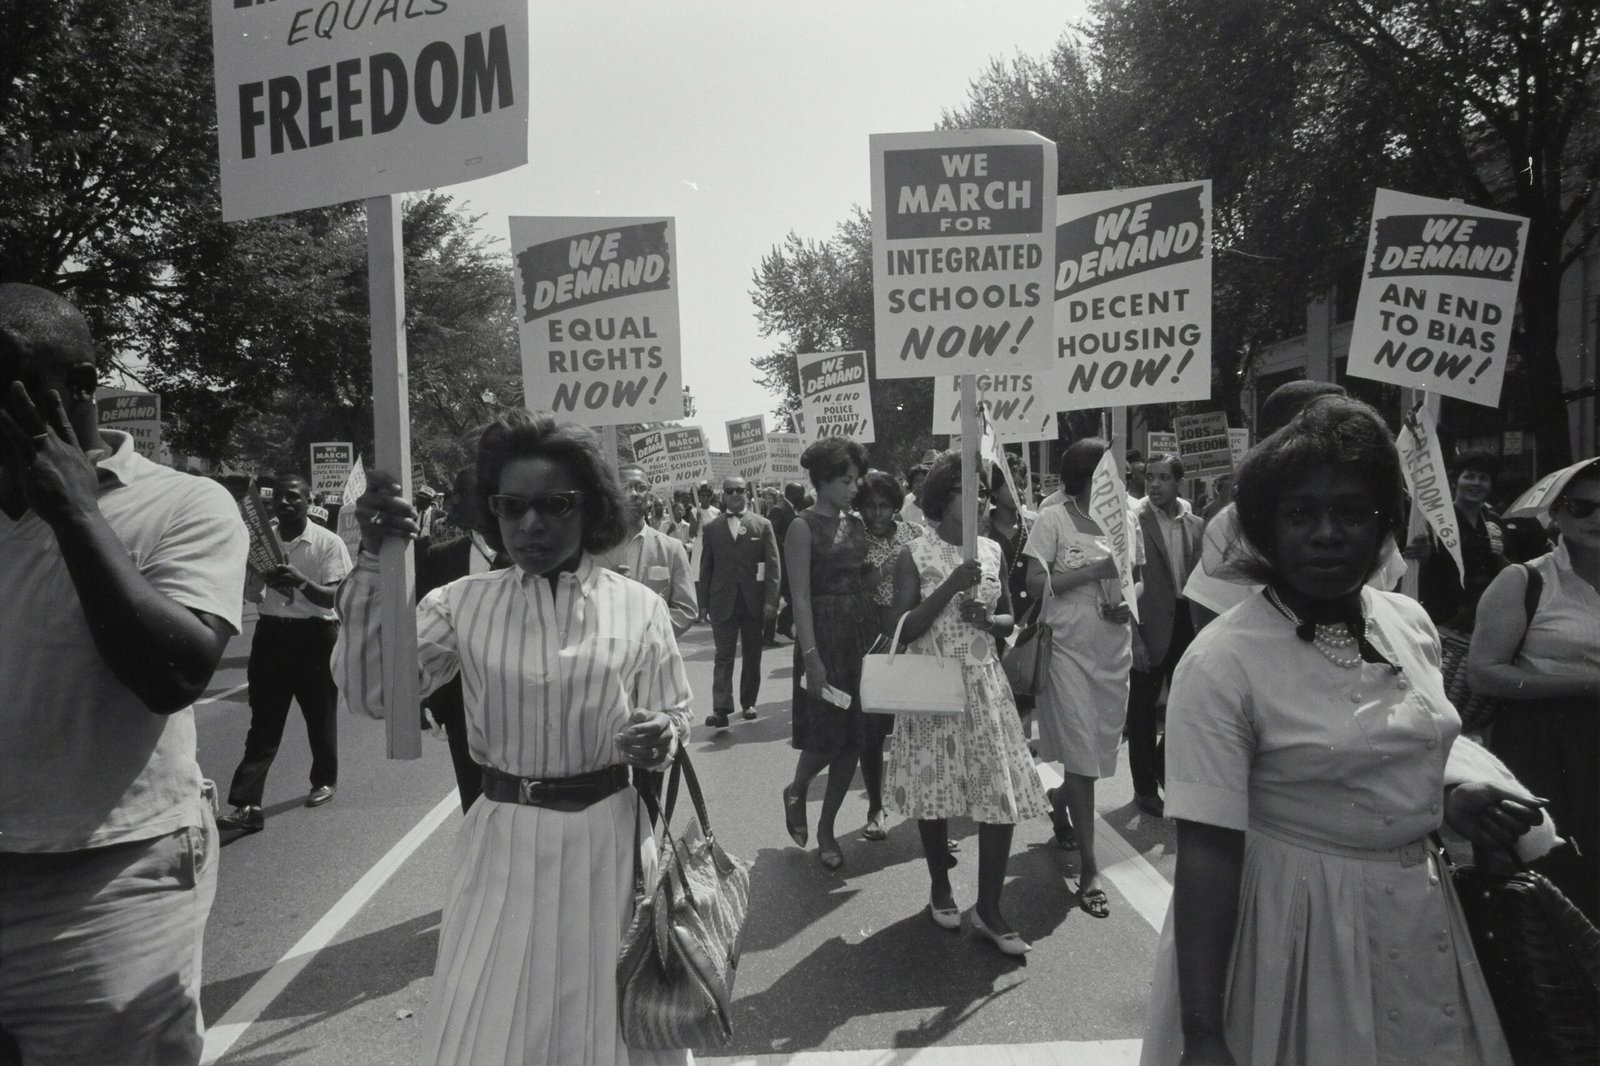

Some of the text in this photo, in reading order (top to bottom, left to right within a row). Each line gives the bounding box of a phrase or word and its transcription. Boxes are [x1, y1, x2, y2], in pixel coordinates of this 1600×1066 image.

[239, 24, 514, 160] FREEDOM
[941, 153, 988, 177] WE
[897, 180, 1031, 214] MARCH
[940, 216, 991, 232] FOR
[1095, 202, 1152, 245] WE
[1422, 217, 1477, 243] WE
[569, 232, 621, 269] WE
[887, 243, 1043, 276] INTEGRATED
[1055, 221, 1198, 291] DEMAND
[1379, 244, 1513, 272] DEMAND
[533, 254, 664, 310] DEMAND
[888, 282, 1041, 314] SCHOOLS
[1070, 288, 1190, 323] DECENT
[1379, 283, 1502, 325] AN END
[548, 316, 657, 342] EQUAL
[900, 315, 1034, 361] NOW!
[1379, 310, 1495, 353] TO BIAS
[1058, 323, 1201, 358] HOUSING
[549, 346, 663, 373] RIGHTS
[821, 357, 844, 374] WE
[1374, 339, 1492, 385] NOW!
[807, 365, 862, 393] DEMAND
[1068, 348, 1194, 394] NOW!
[552, 371, 667, 412] NOW!
[953, 375, 1033, 392] RGHTS
[116, 397, 139, 408] WE
[813, 394, 831, 403] AN
[836, 392, 860, 401] END
[951, 394, 1034, 422] W!
[102, 406, 155, 421] DEMAND
[816, 413, 859, 424] BRUTALITY
[824, 405, 853, 414] POLICE
[733, 427, 761, 441] MARCH
[741, 422, 751, 430] WE
[817, 418, 867, 439] NOW!
[1180, 426, 1210, 440] JOBS
[638, 442, 661, 458] DEMA
[645, 433, 660, 446] WE
[668, 436, 699, 448] MARCH
[1180, 438, 1228, 455] FREEDOM
[642, 456, 653, 464] AN
[668, 450, 705, 462] INTEGRATED
[733, 447, 748, 458] FIRST
[749, 443, 766, 455] CLASS
[733, 451, 767, 467] CITIZENSHIP
[650, 462, 667, 470] POLICE
[670, 458, 707, 471] SCHOOLS
[675, 466, 707, 481] NOW!
[740, 461, 767, 478] NOW!
[772, 464, 798, 472] REEDOM
[243, 495, 261, 529] MARCH
[1091, 468, 1127, 559] FREEDOM
[1434, 513, 1445, 525] IN
